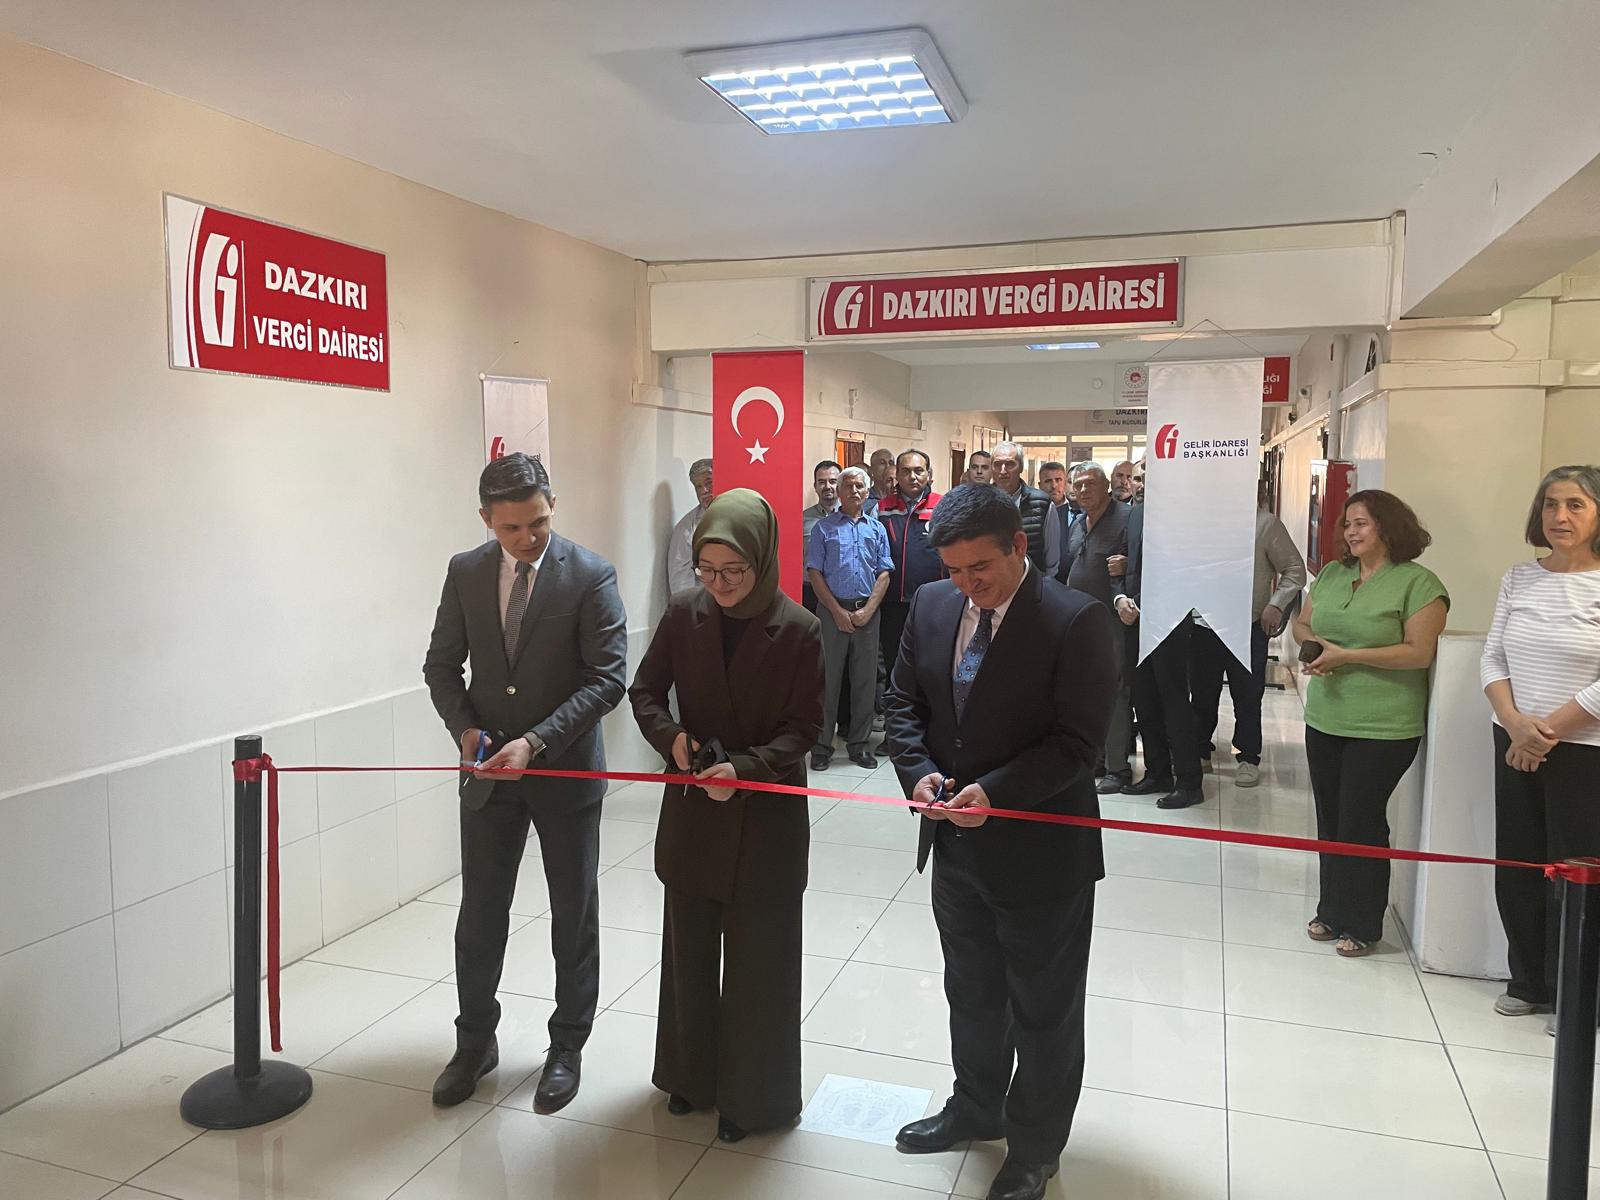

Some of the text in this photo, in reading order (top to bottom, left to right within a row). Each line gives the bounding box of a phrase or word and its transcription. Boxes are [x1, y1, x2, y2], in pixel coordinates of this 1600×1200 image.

[265, 261, 367, 310] DAZKIRI
[883, 272, 1165, 320] DAZKIRI VERGİ DAİRESİ
[253, 315, 384, 363] VERGİ DAİRESİ
[1184, 438, 1249, 449] GELİR İDARESİ
[1184, 448, 1249, 459] BAŞKANLIĞI
